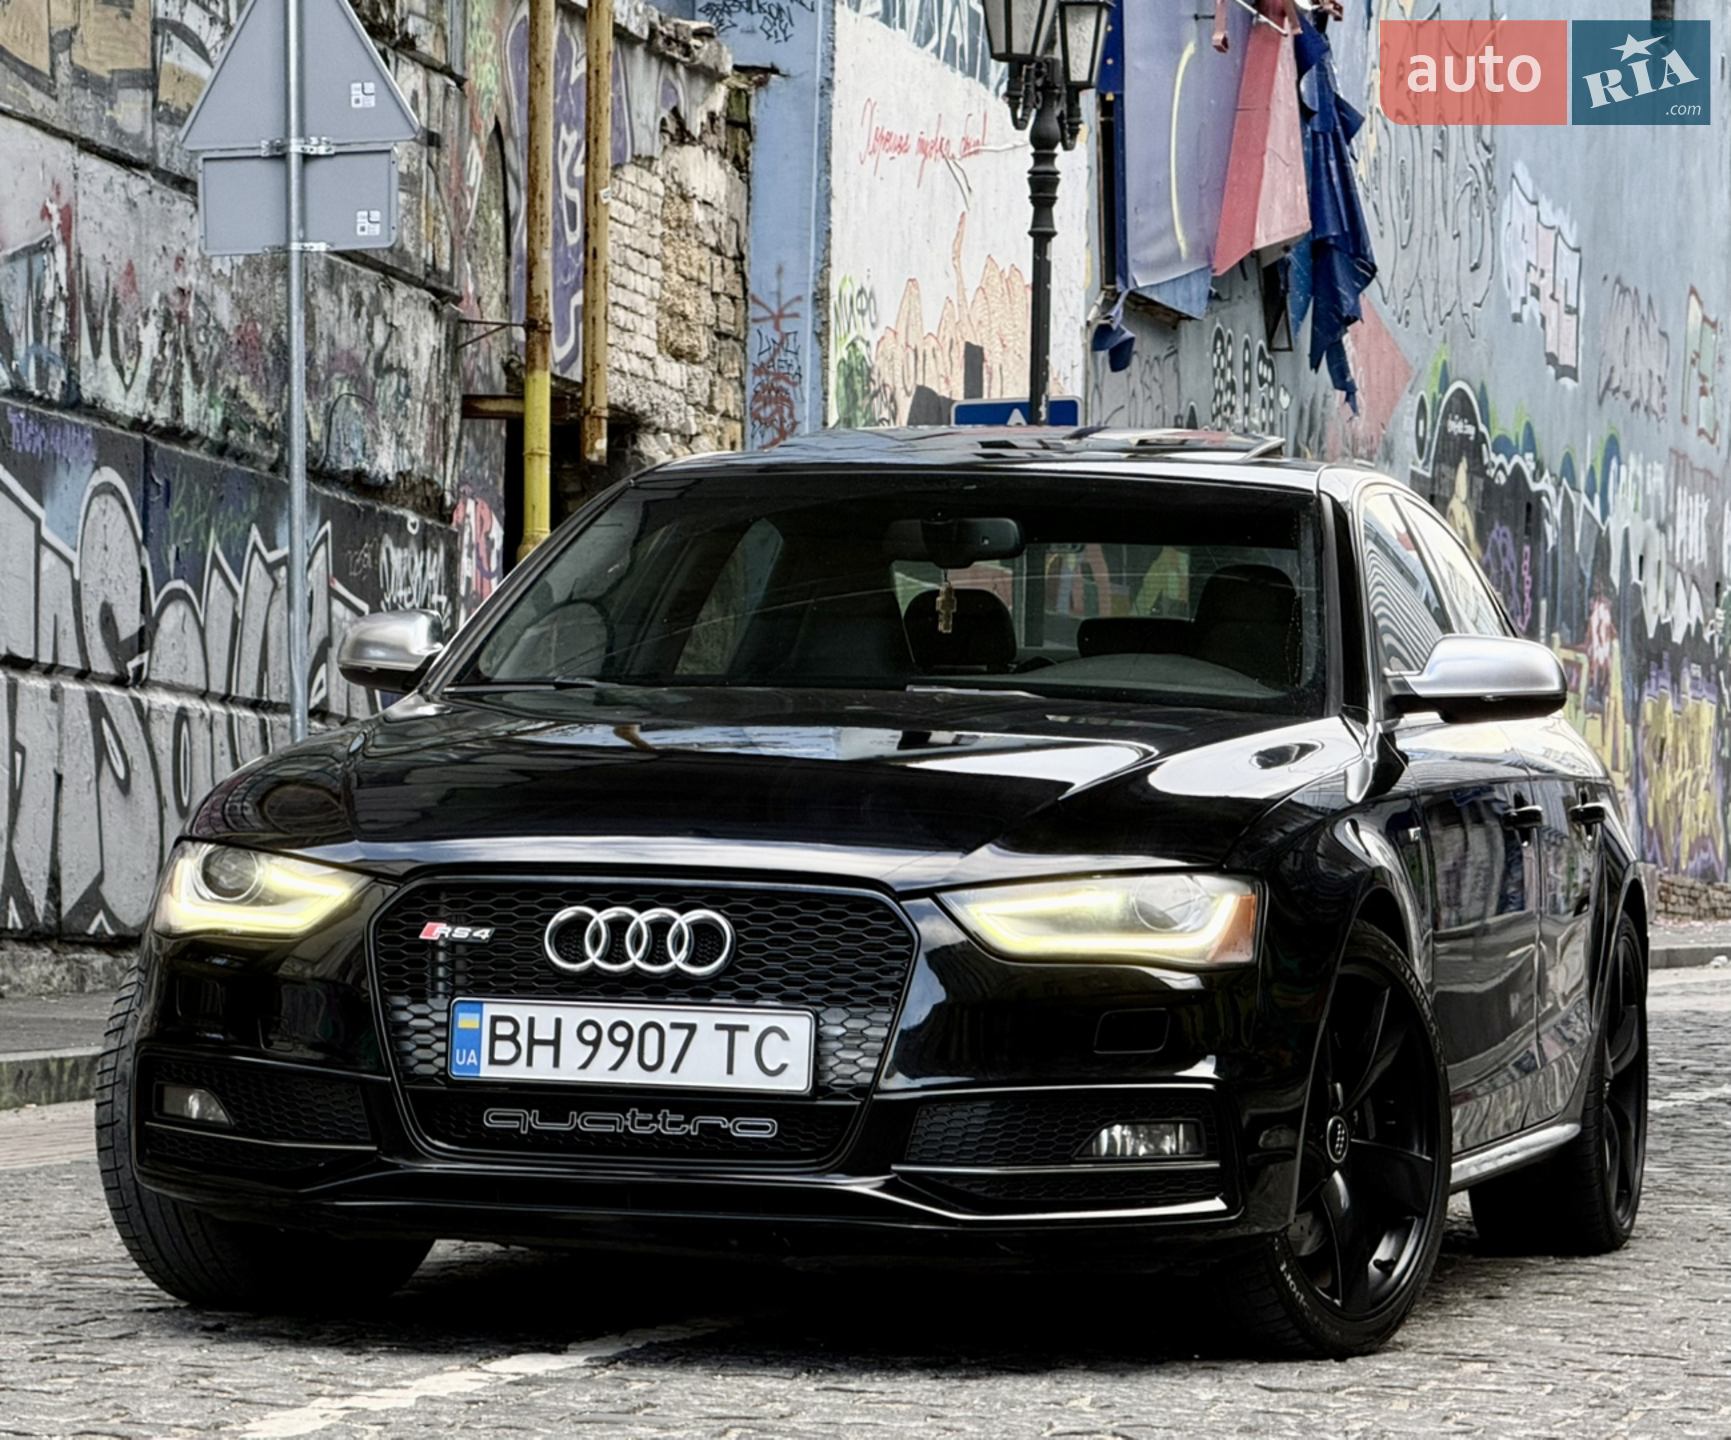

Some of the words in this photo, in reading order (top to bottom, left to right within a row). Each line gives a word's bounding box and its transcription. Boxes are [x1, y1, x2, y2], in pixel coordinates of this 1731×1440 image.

[423, 922, 493, 941] RS4
[456, 1049, 478, 1066] UA
[488, 1015, 562, 1068] BH
[576, 1019, 697, 1074] 9907
[714, 1023, 791, 1077] TC
[483, 1107, 778, 1138] quattro
